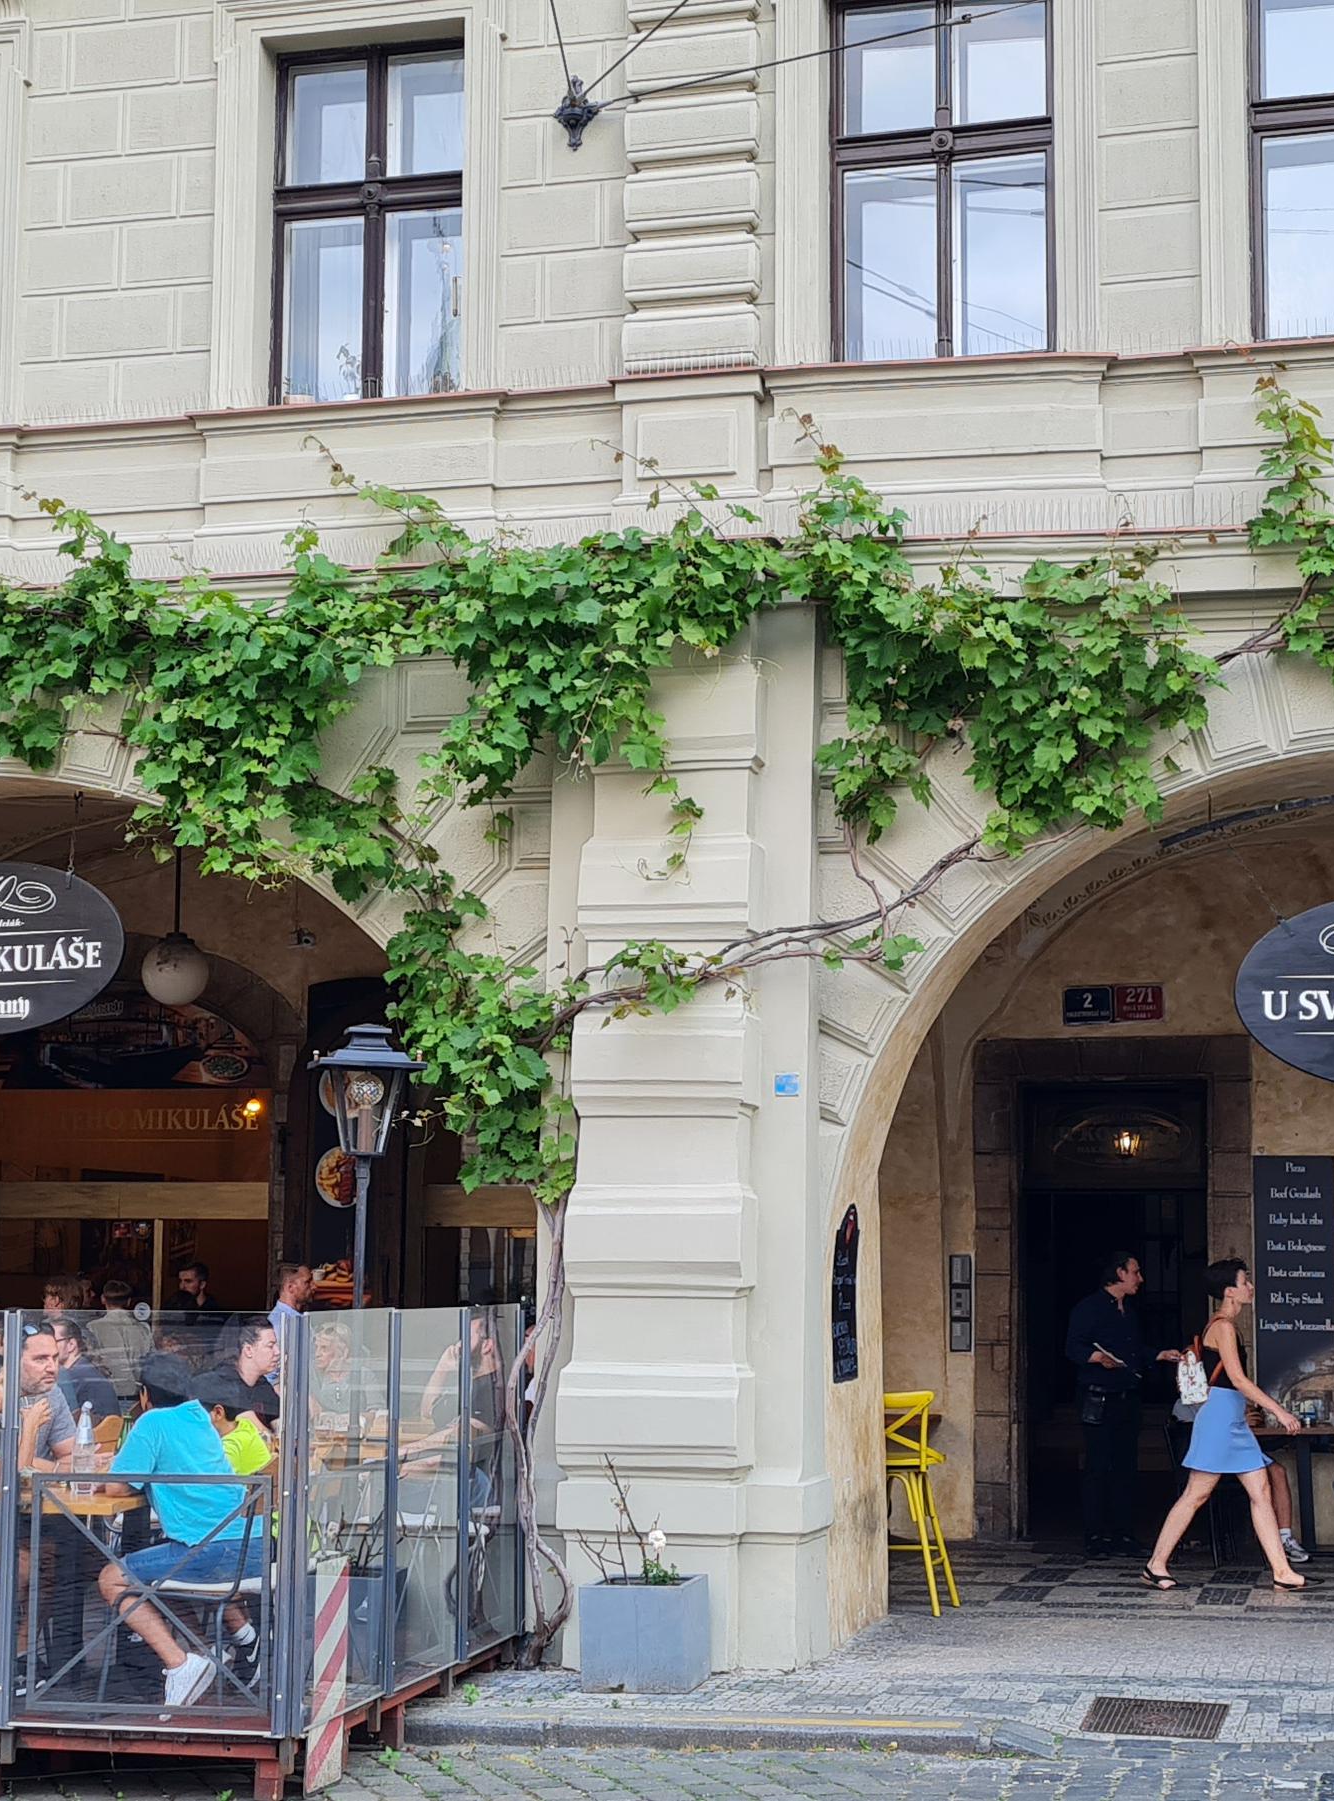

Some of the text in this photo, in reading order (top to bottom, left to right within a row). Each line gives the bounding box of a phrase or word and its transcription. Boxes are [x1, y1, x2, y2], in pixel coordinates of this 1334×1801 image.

[1083, 993, 1093, 1008] 2
[1125, 987, 1154, 1003] 271
[1261, 990, 1289, 1021] U
[1270, 1186, 1288, 1198] Beef
[1269, 1212, 1288, 1228] Baby
[1267, 1240, 1286, 1251] Pasta
[1268, 1266, 1287, 1277] Pasta
[1270, 1291, 1324, 1307] Rib Eye Steak
